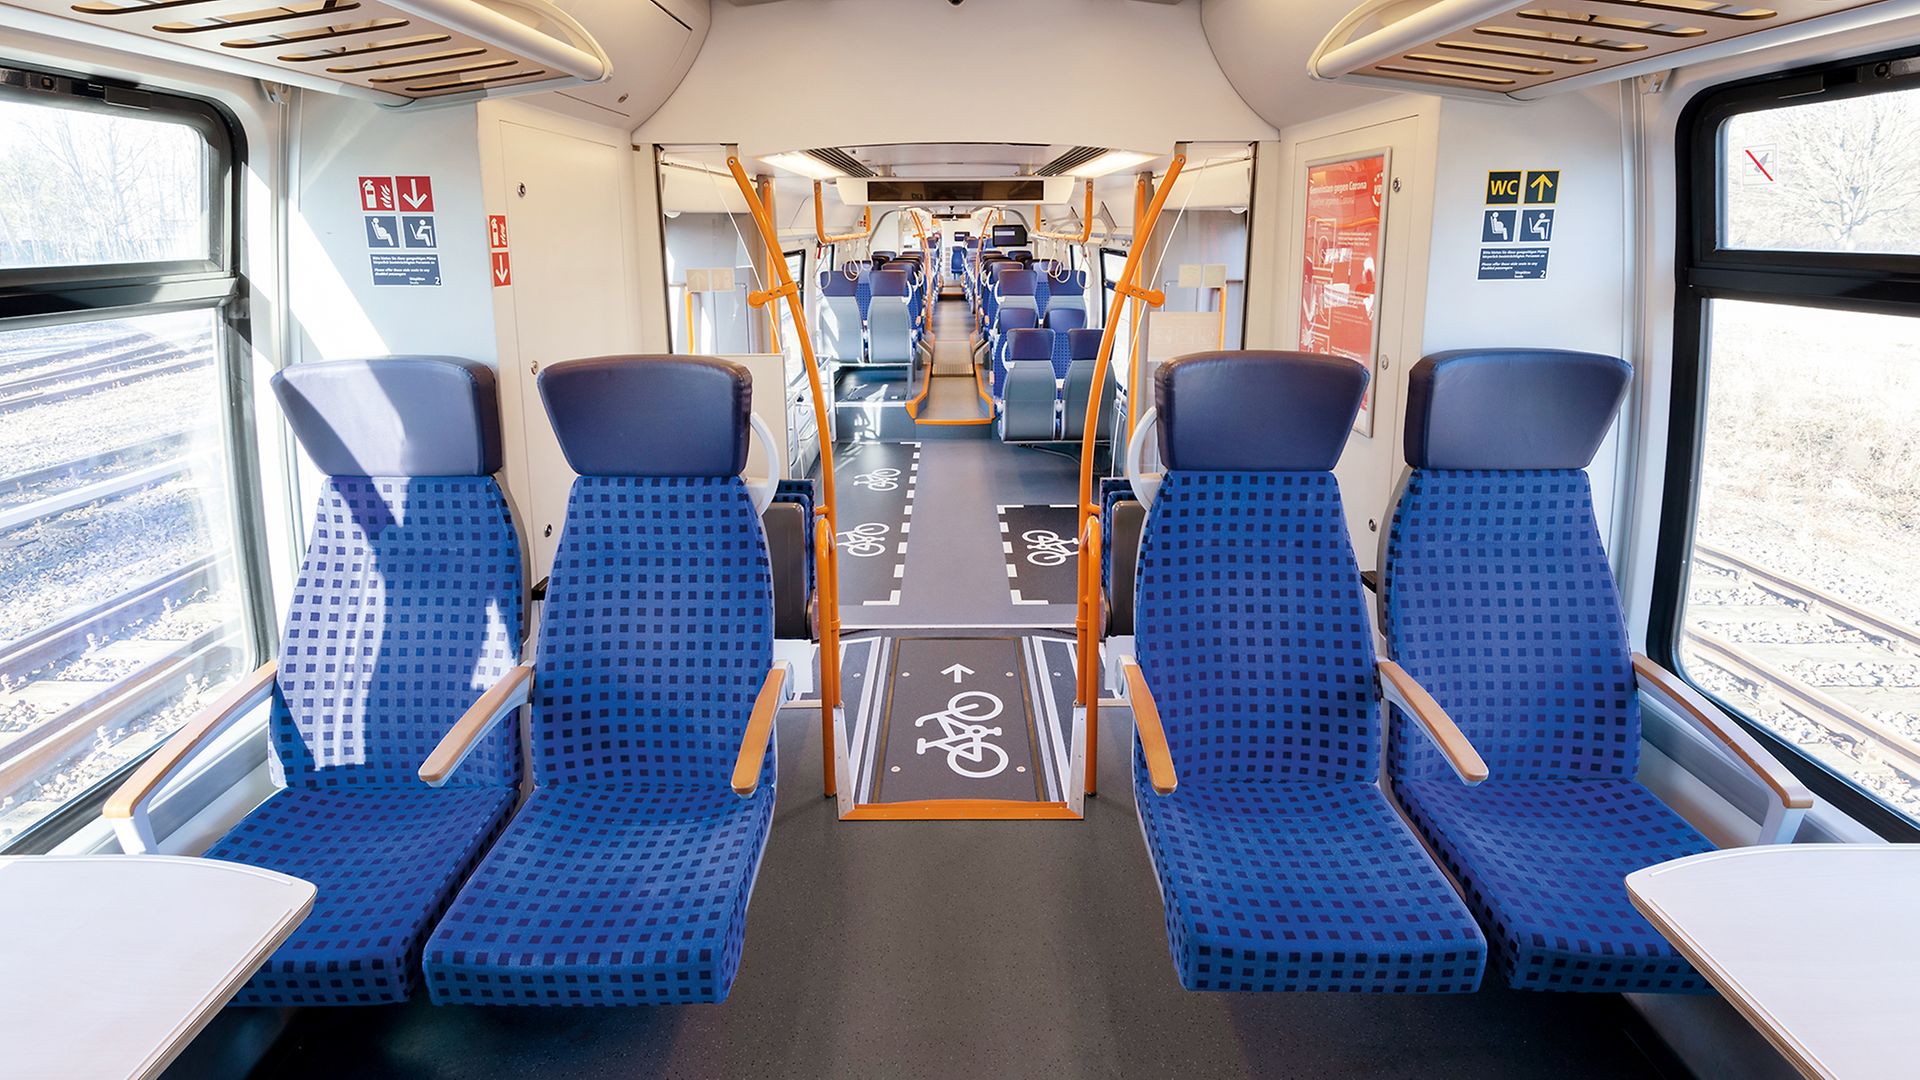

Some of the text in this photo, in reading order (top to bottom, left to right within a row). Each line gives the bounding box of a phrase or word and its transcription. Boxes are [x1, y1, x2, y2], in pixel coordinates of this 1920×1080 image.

[1349, 181, 1367, 191] Corona
[1491, 180, 1518, 195] WC
[1540, 270, 1545, 278] 2
[435, 276, 440, 285] 2
